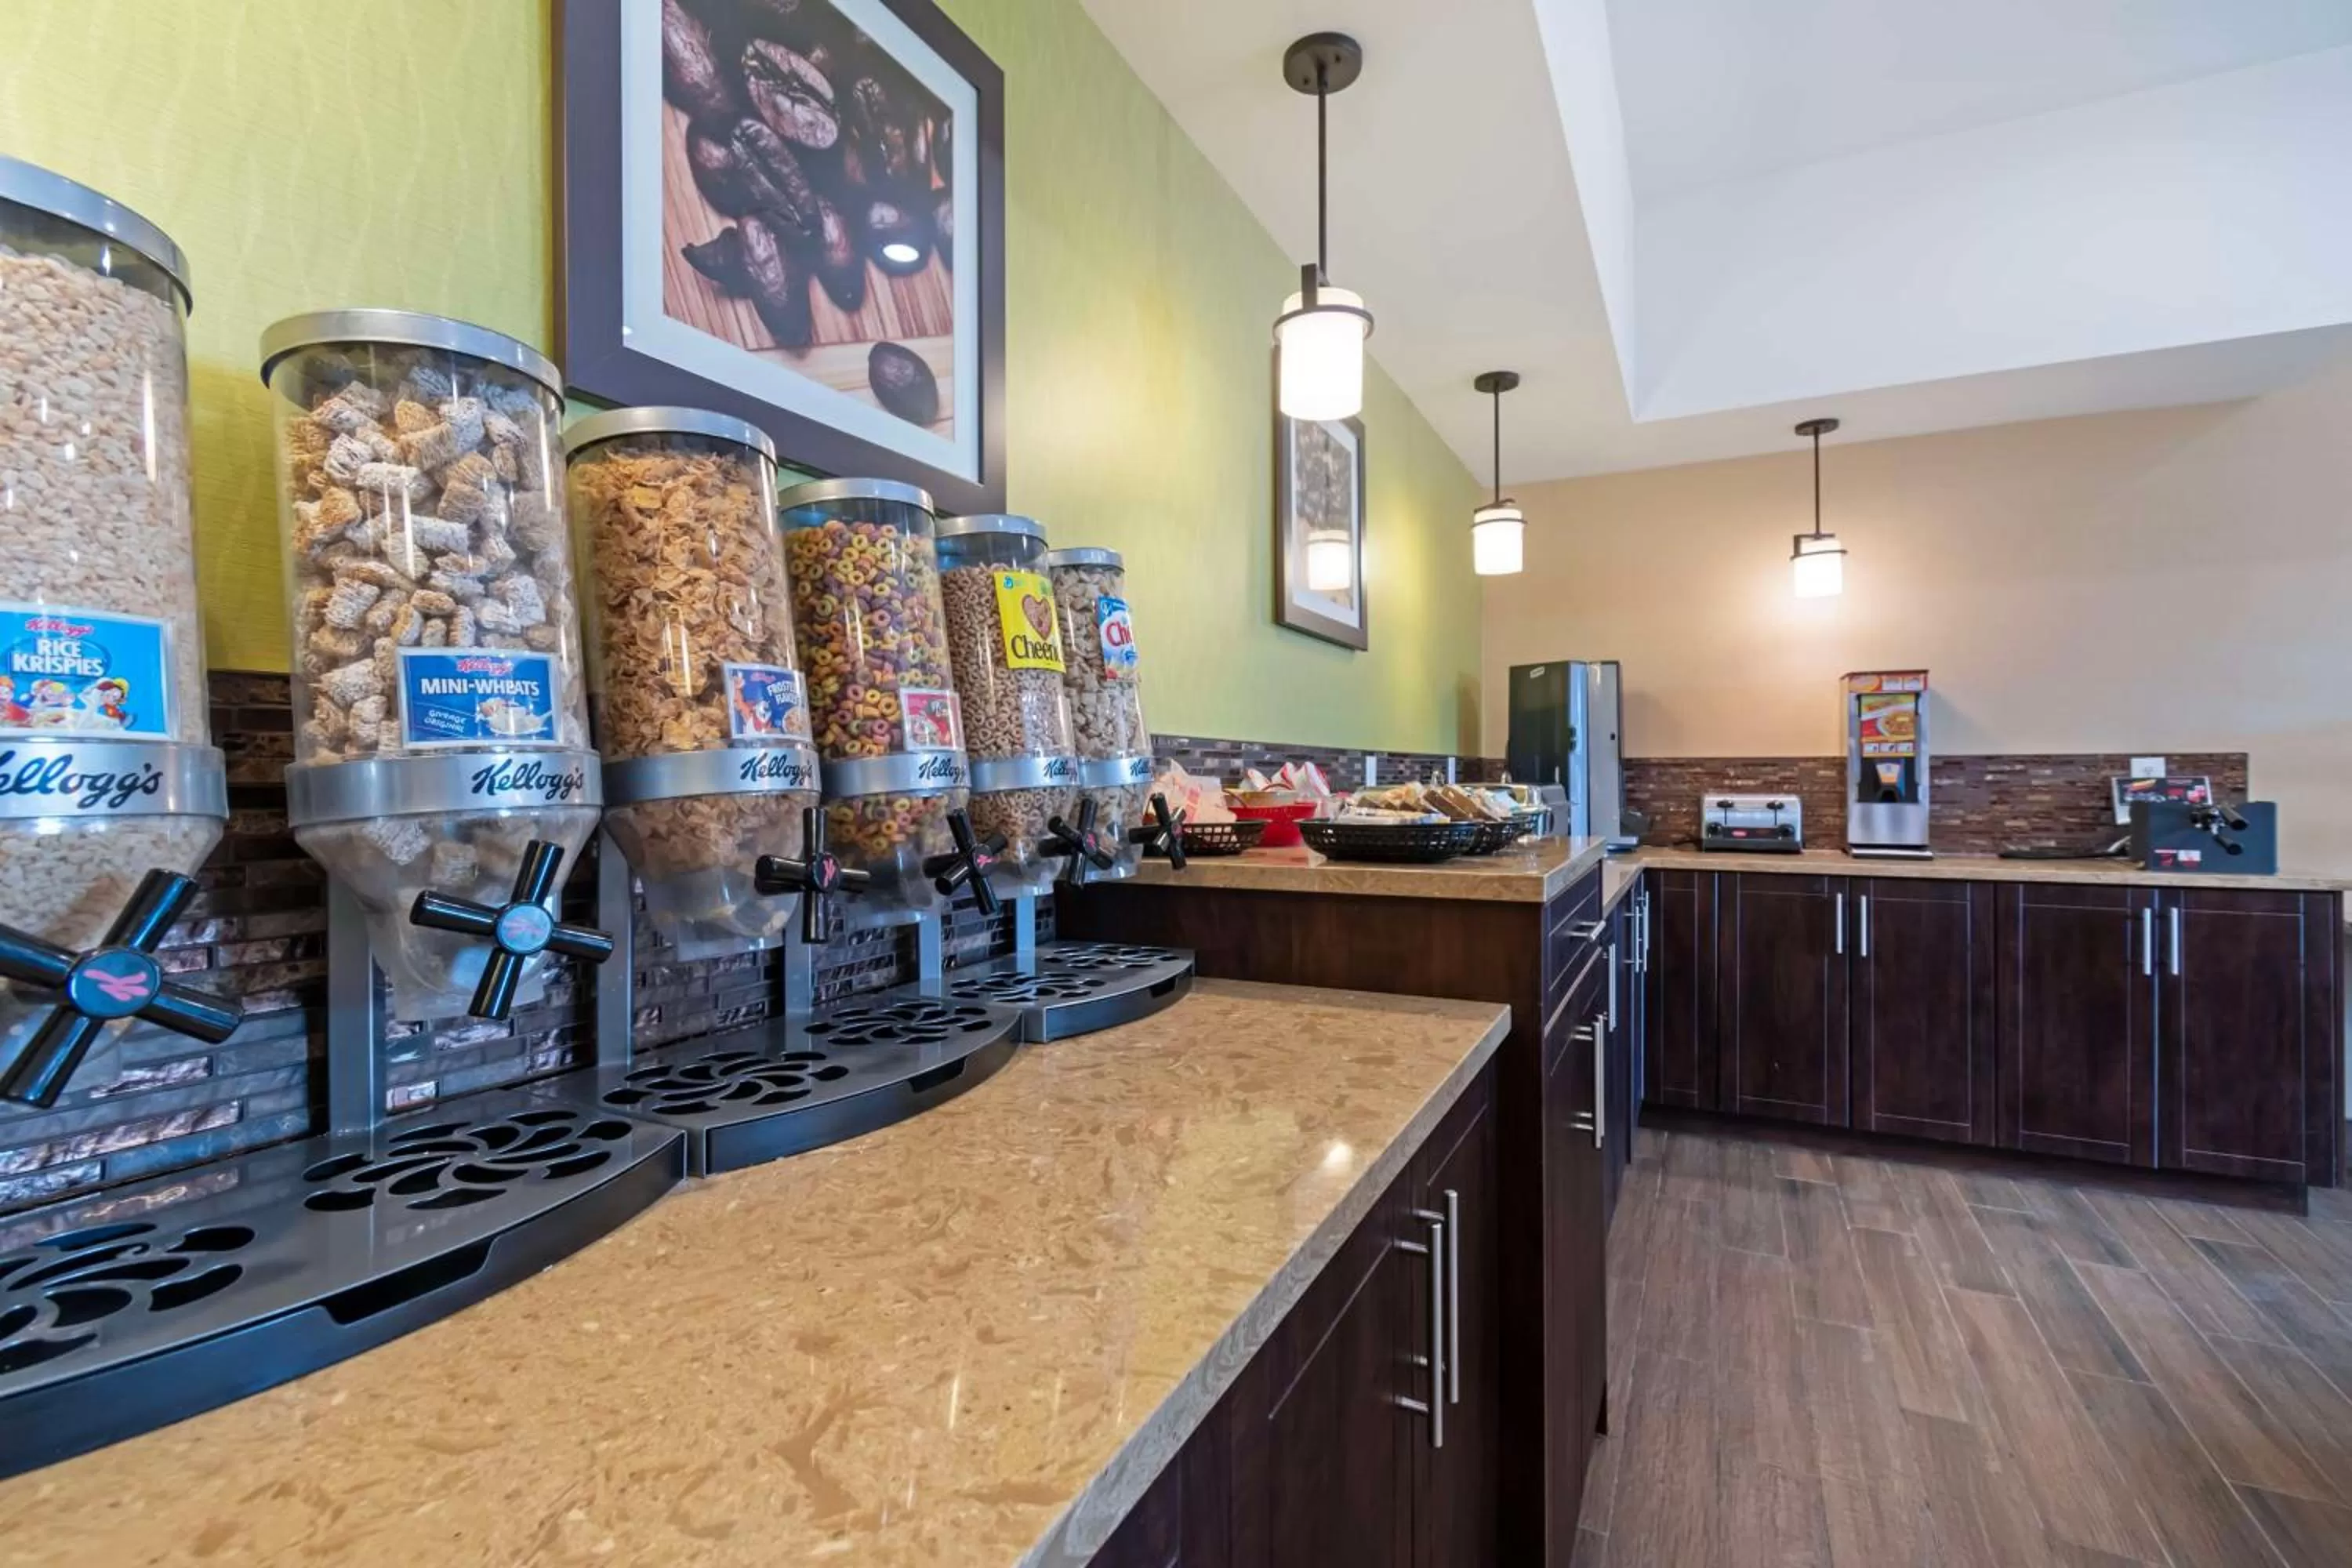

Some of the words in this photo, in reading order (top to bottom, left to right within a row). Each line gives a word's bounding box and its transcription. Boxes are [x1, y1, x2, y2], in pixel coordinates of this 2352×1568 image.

[37, 639, 82, 658] RICE
[13, 653, 104, 677] KRISPIES
[421, 677, 540, 697] MINI-WHEATS
[0, 750, 163, 809] ellogg's
[471, 758, 584, 800] Kellogg's
[740, 752, 813, 786] Kellogg's
